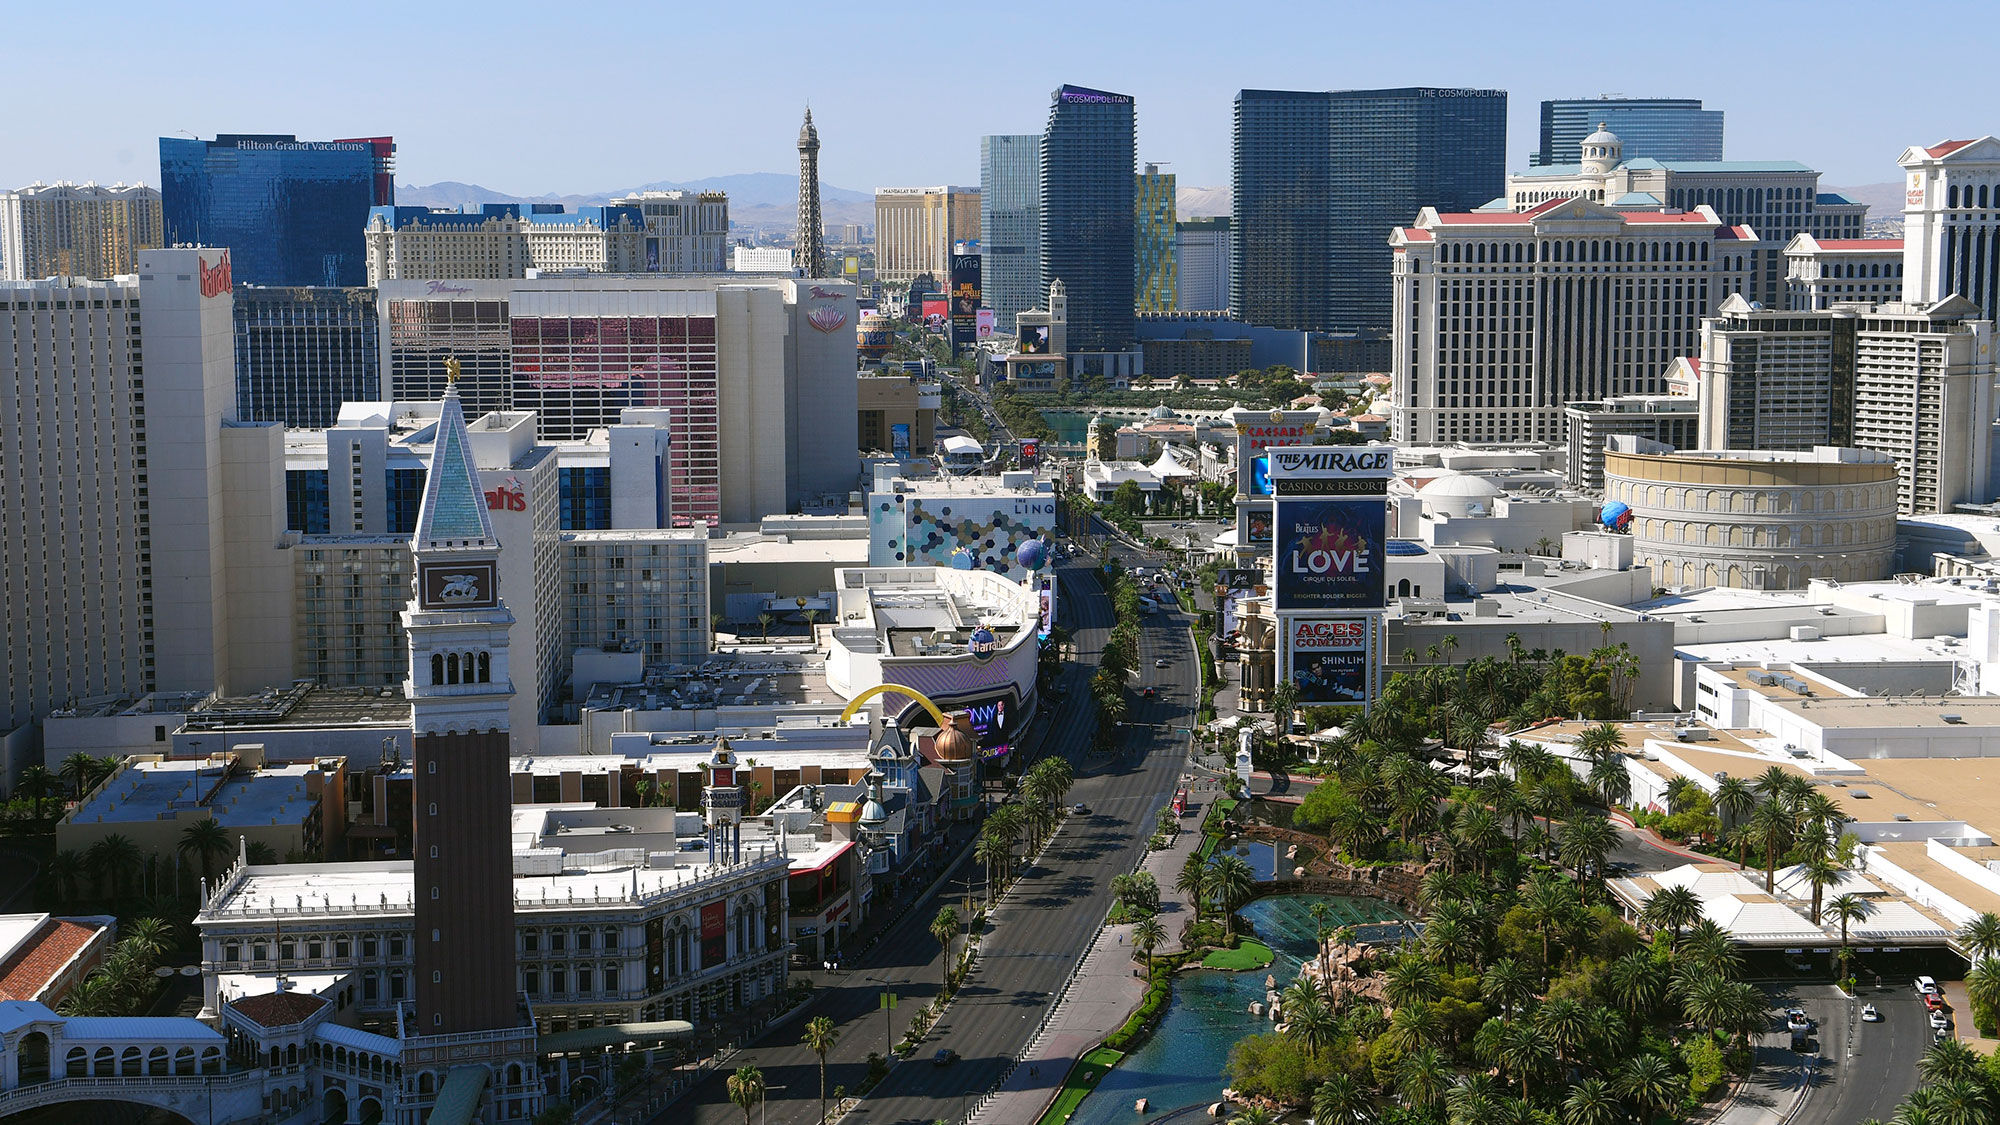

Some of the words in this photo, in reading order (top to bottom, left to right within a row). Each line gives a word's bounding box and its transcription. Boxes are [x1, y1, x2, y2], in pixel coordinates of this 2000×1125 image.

[1419, 89, 1436, 97] THE
[1438, 89, 1506, 97] COSMOPOLITAN
[1068, 96, 1129, 104] COSMOPOLITAN
[237, 140, 273, 151] Hilton
[275, 140, 309, 151] Grand
[311, 141, 365, 151] Vacations
[955, 256, 979, 270] Aria
[425, 279, 473, 297] Flamingo
[1247, 427, 1305, 437] CAESARS
[1276, 453, 1301, 464] THE
[1282, 453, 1389, 472] MIRAGE
[1279, 482, 1323, 492] CASINO
[1326, 482, 1335, 491] &
[1339, 481, 1386, 492] RESORT
[1014, 504, 1055, 515] LINQ
[1292, 549, 1370, 574] LOVE
[1295, 623, 1364, 638] ACES
[1295, 638, 1364, 648] COMEDY
[1321, 656, 1346, 665] SHIN
[1347, 656, 1365, 665] LIM
